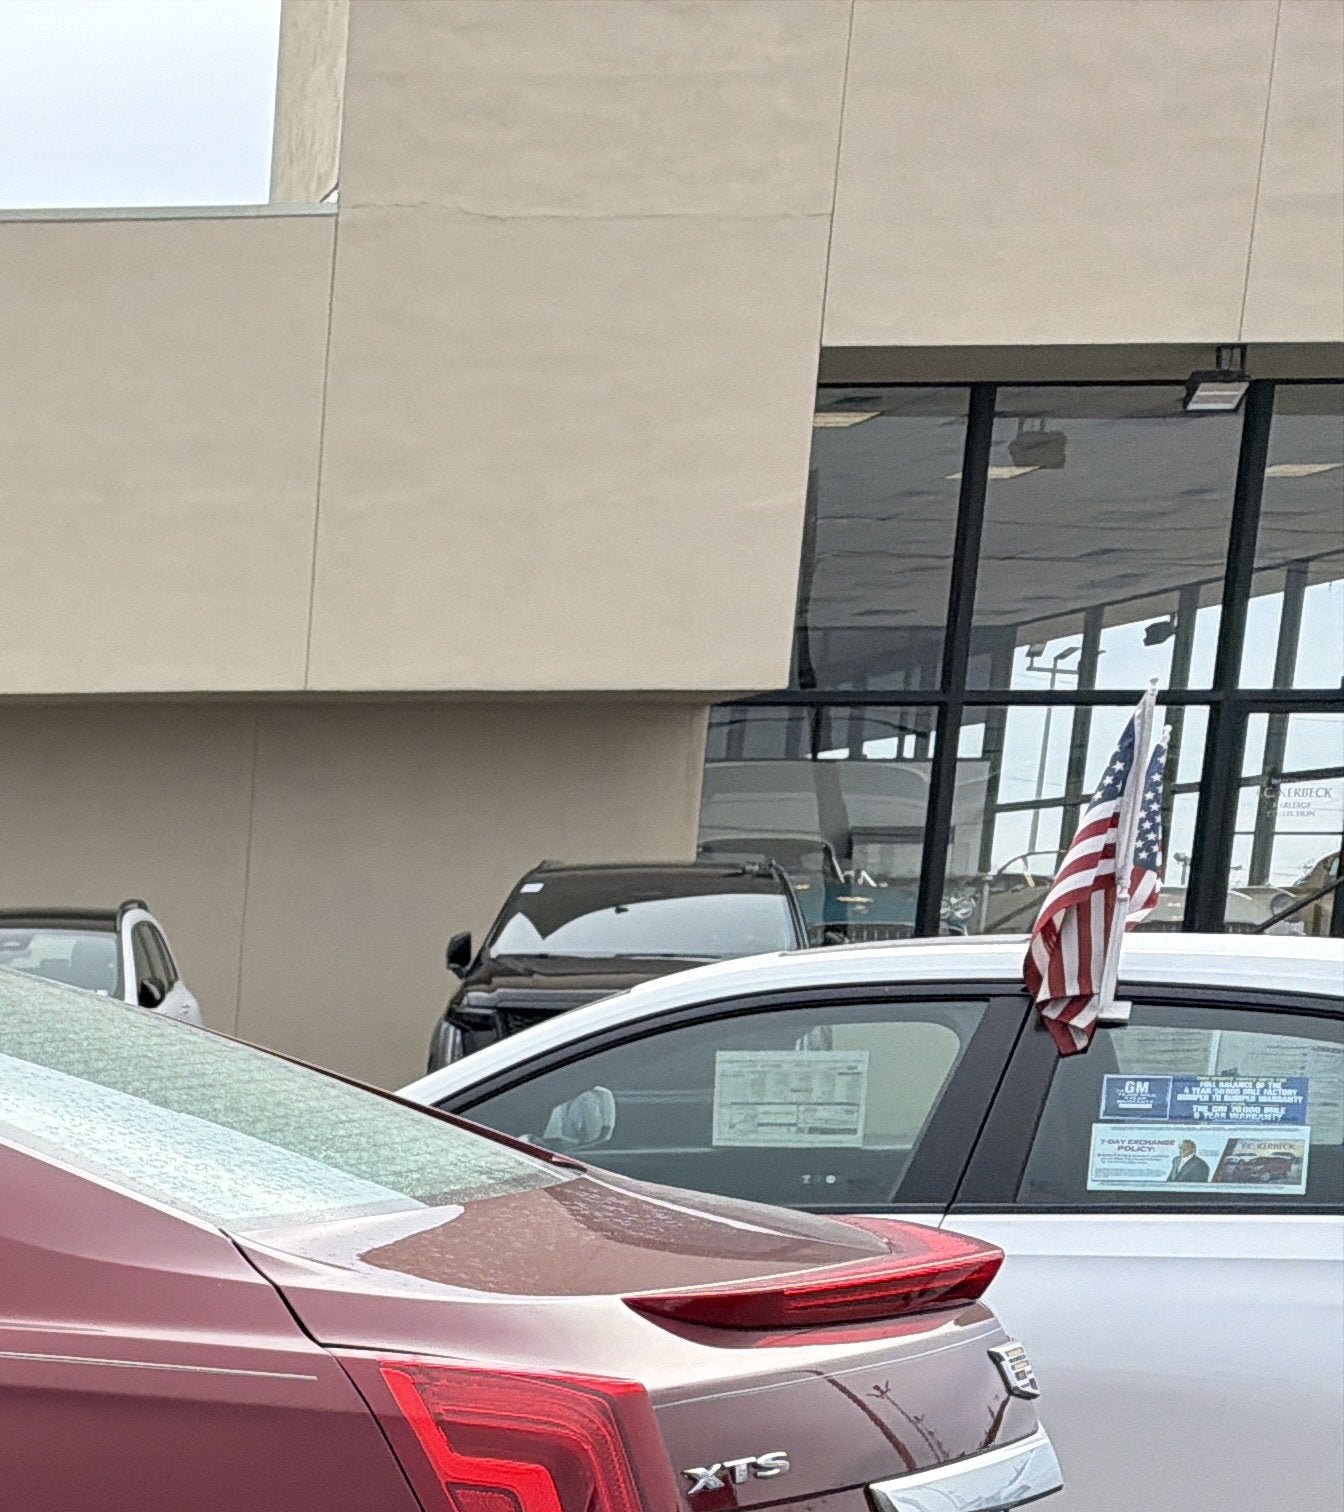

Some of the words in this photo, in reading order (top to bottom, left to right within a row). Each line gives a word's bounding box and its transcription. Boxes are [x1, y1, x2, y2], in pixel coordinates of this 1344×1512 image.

[1124, 1081, 1150, 1093] GM
[1263, 1088, 1298, 1096] FACTORY
[682, 1451, 790, 1495] XTS
